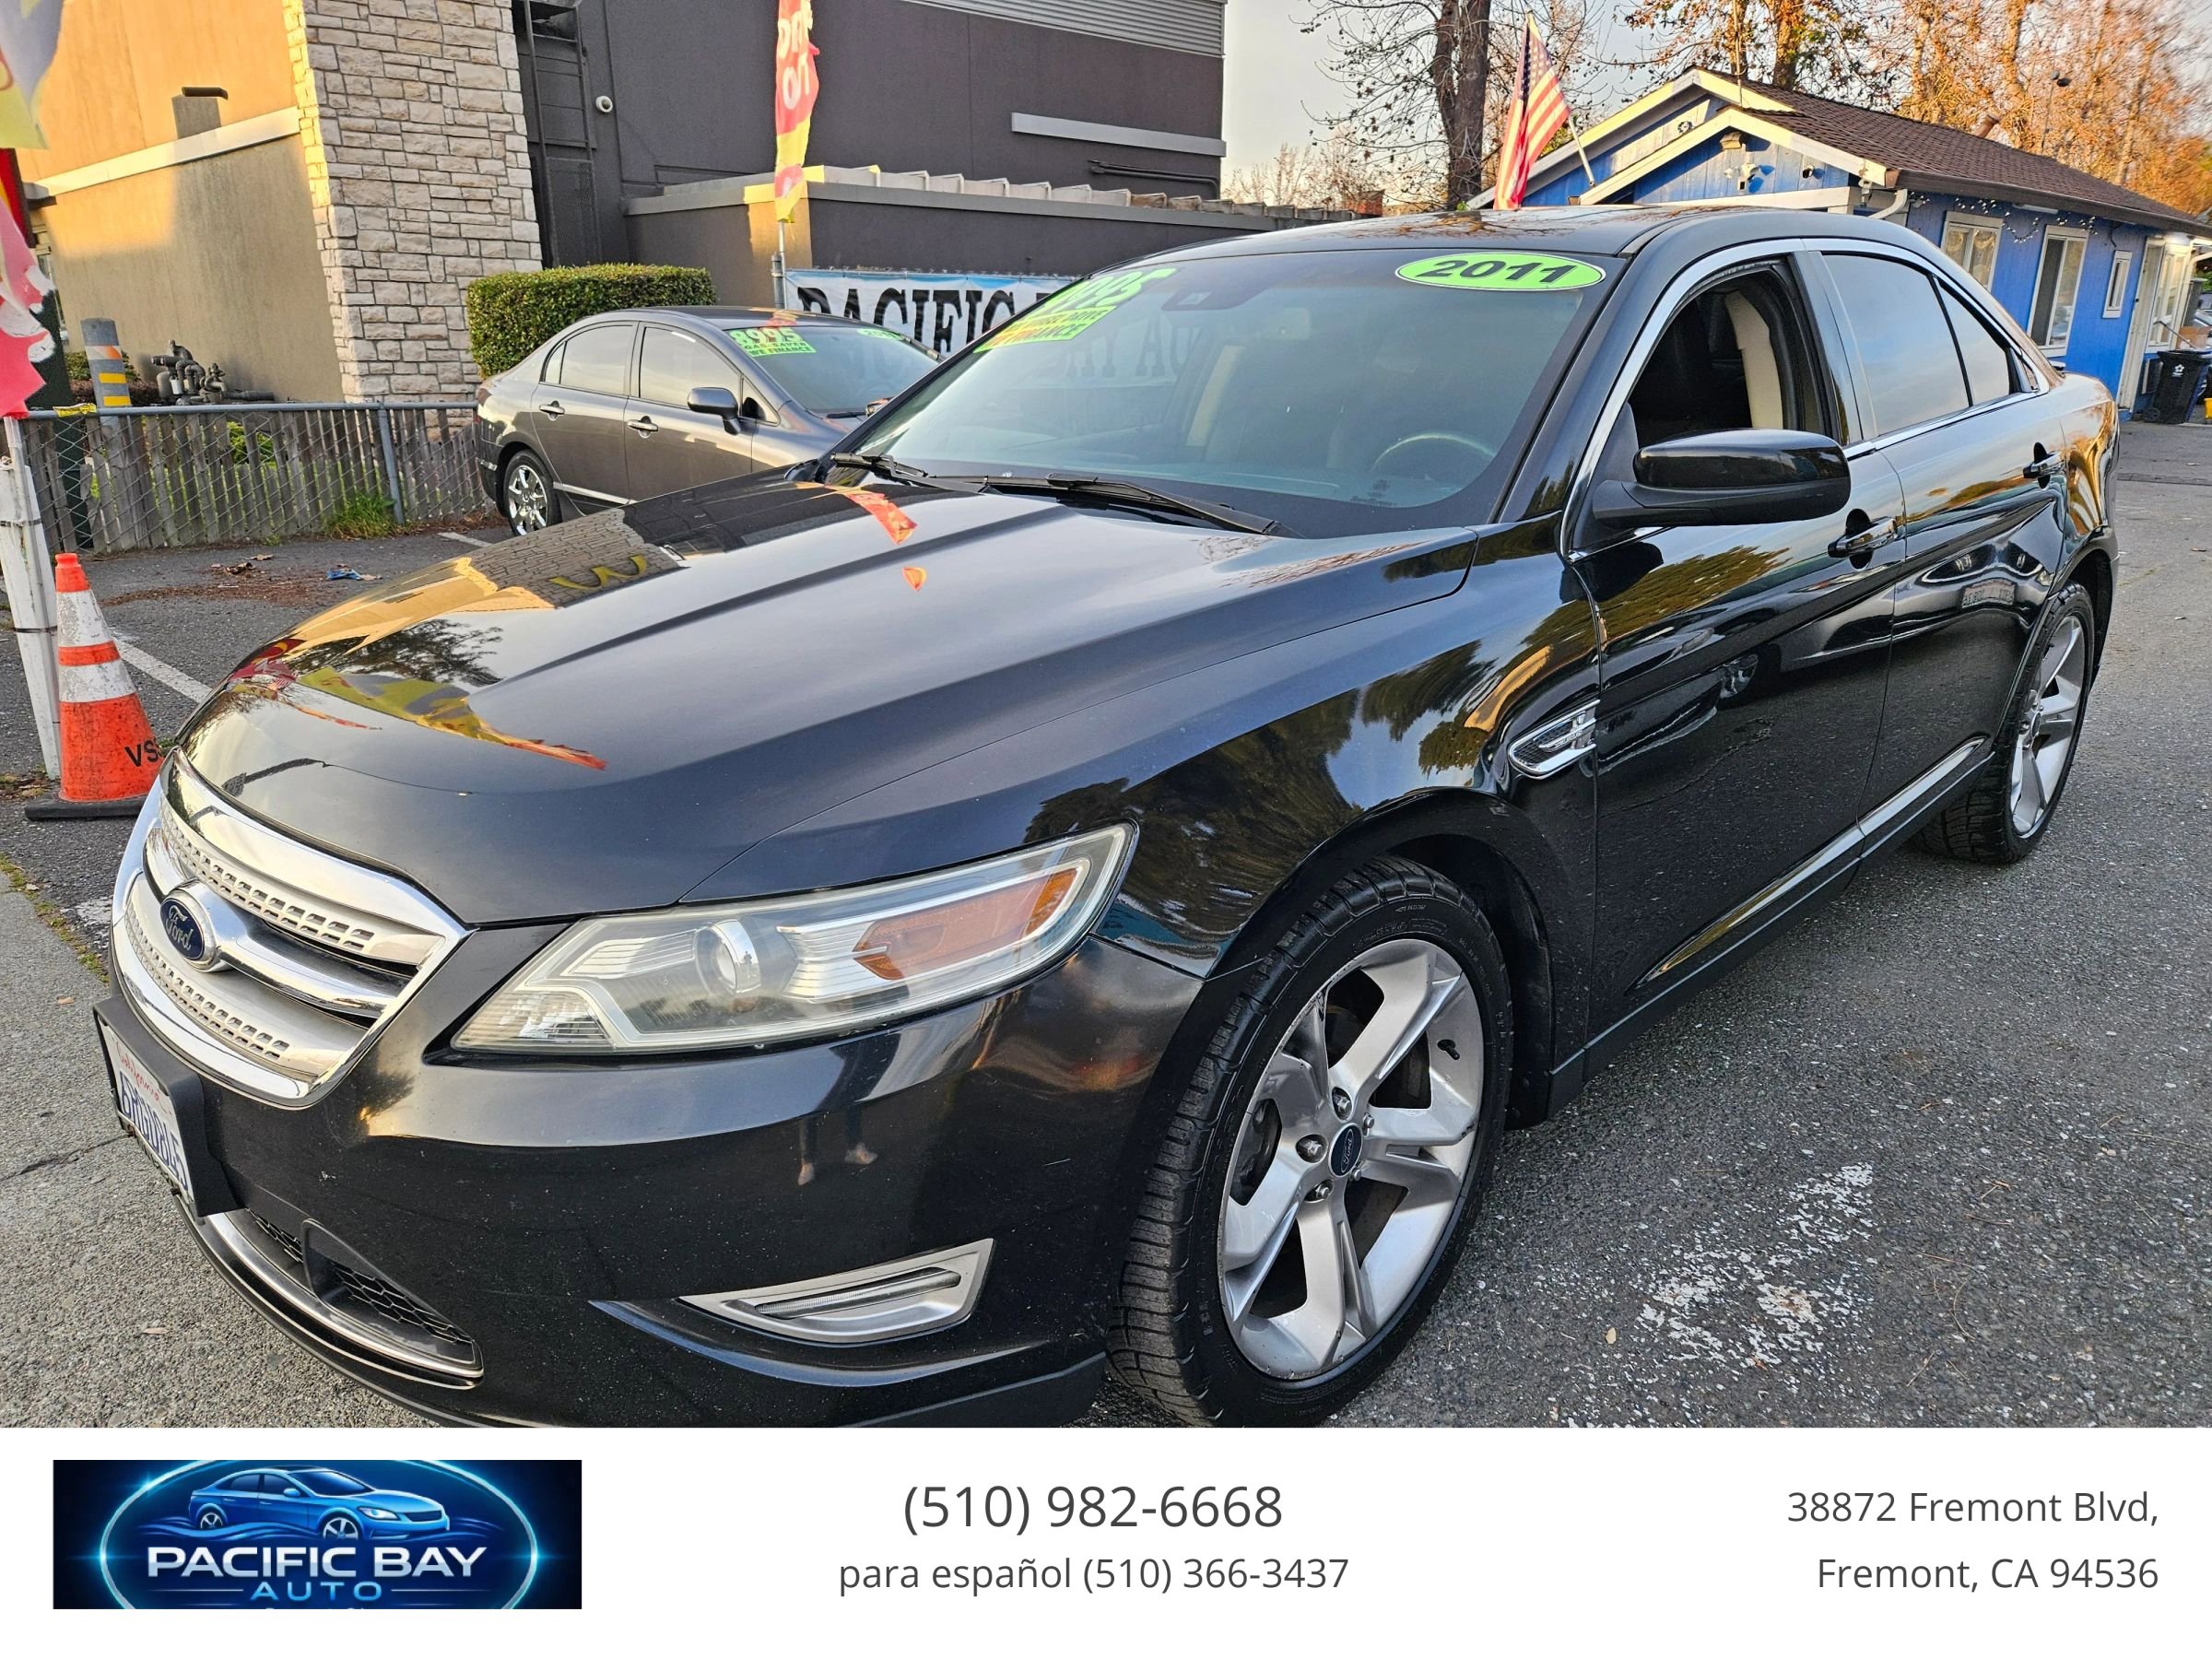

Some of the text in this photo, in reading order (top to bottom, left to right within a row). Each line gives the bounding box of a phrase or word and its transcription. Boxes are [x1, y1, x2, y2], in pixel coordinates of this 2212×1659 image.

[1415, 260, 1578, 284] 2011
[729, 327, 804, 346] 8995
[124, 736, 164, 768] VS
[166, 904, 194, 951] Ford
